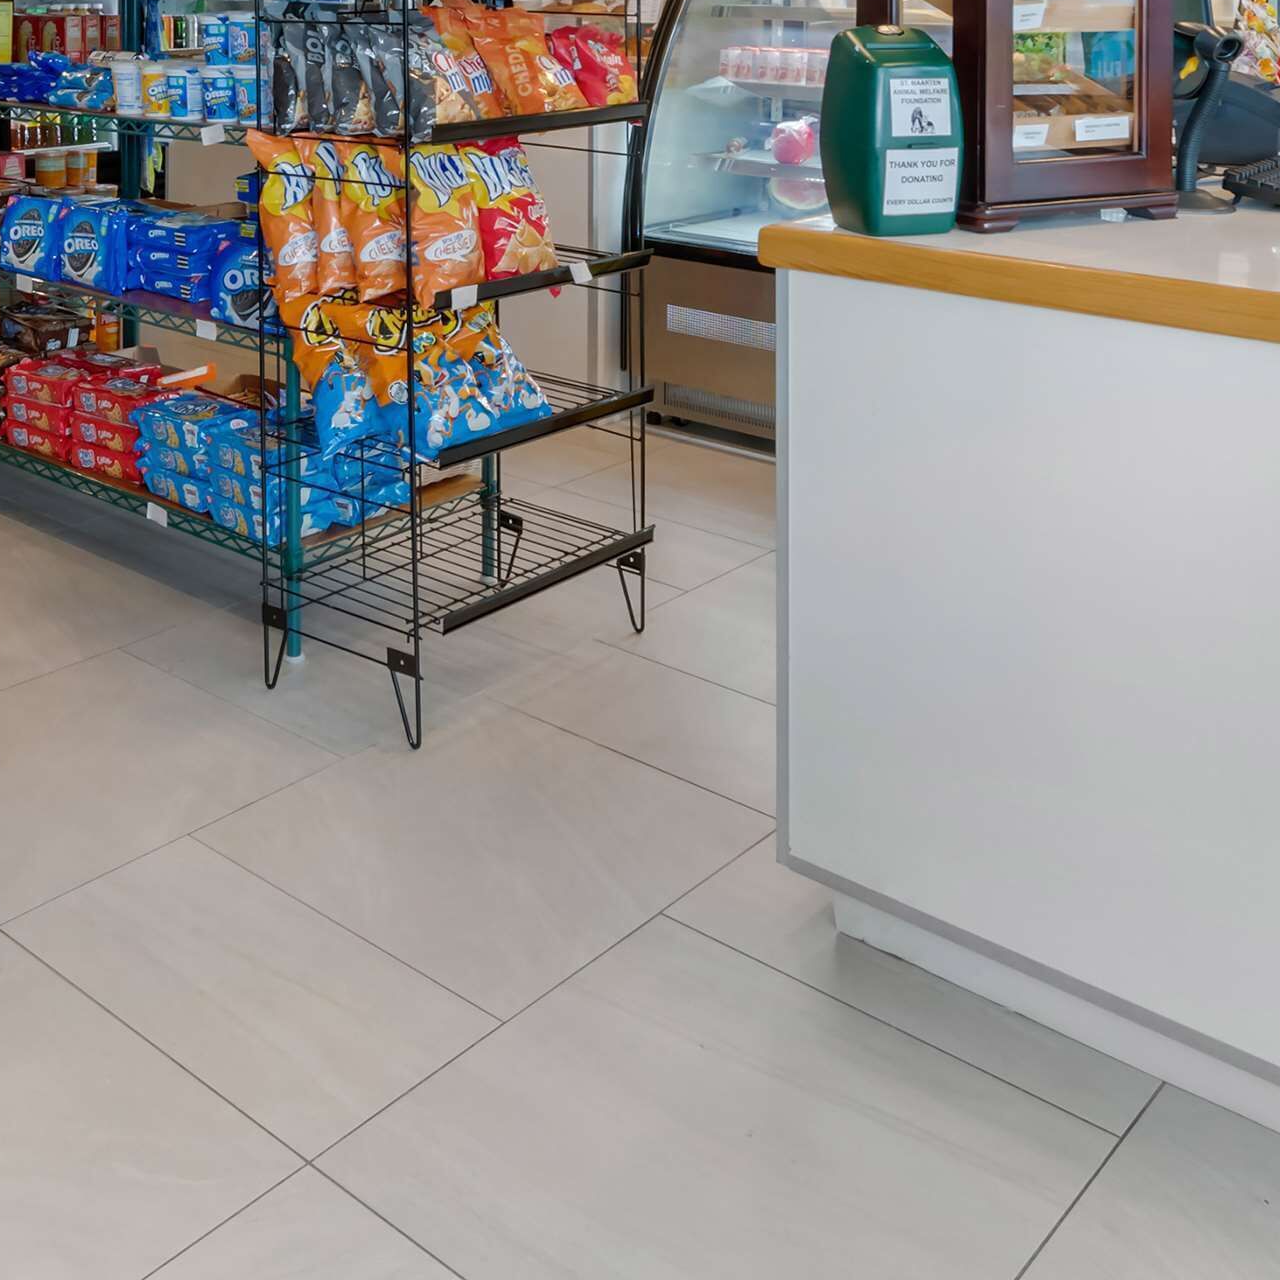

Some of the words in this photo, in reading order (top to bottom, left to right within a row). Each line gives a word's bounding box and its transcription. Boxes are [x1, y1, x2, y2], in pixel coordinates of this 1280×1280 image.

[889, 160, 918, 169] THANK
[920, 160, 938, 168] YOU
[940, 159, 956, 167] FOR
[901, 174, 943, 184] DONATING
[10, 224, 44, 240] OREO
[64, 237, 99, 253] OREO
